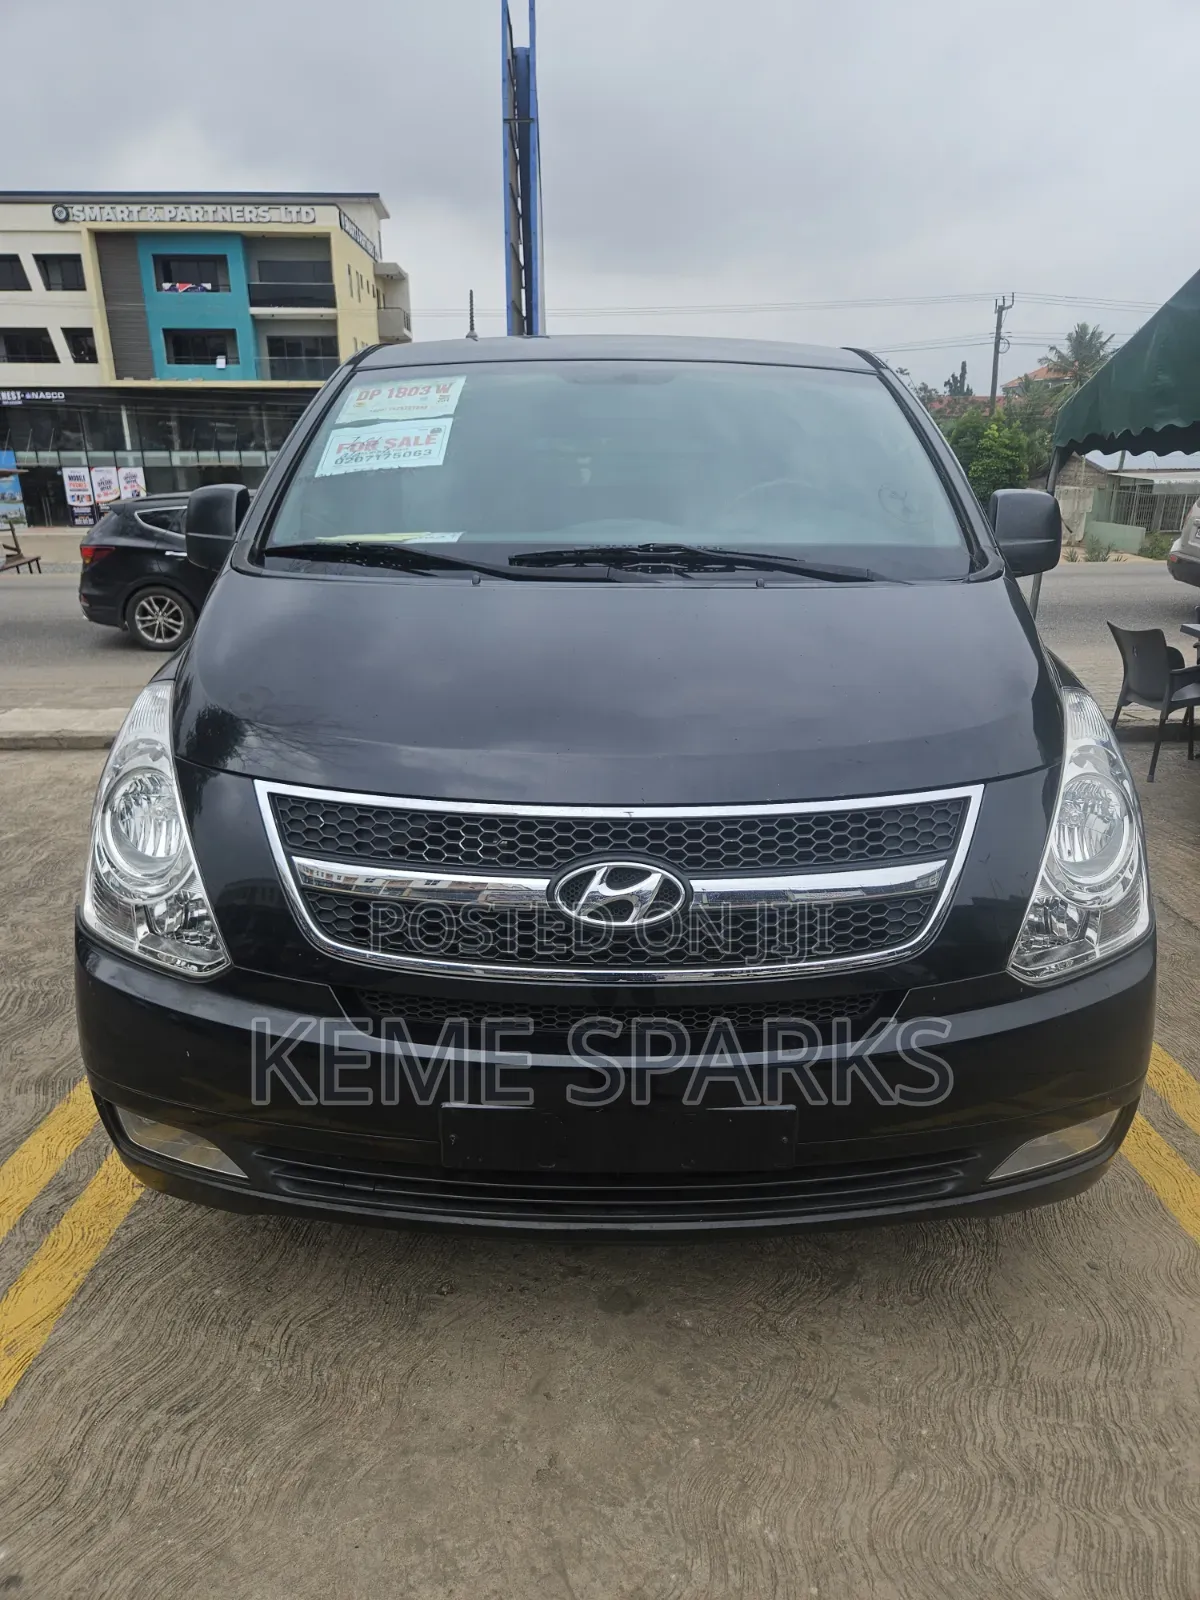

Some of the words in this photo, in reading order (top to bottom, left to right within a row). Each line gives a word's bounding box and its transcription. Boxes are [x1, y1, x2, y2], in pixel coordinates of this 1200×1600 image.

[70, 205, 140, 222] SMART
[147, 205, 160, 222] &
[167, 205, 272, 223] PARTNERS
[280, 206, 316, 223] LTD
[31, 391, 65, 400] NASCO
[356, 389, 382, 401] DP
[387, 385, 432, 399] 1803
[435, 382, 453, 395] W
[337, 441, 379, 454] FOR
[384, 435, 438, 449] SALE
